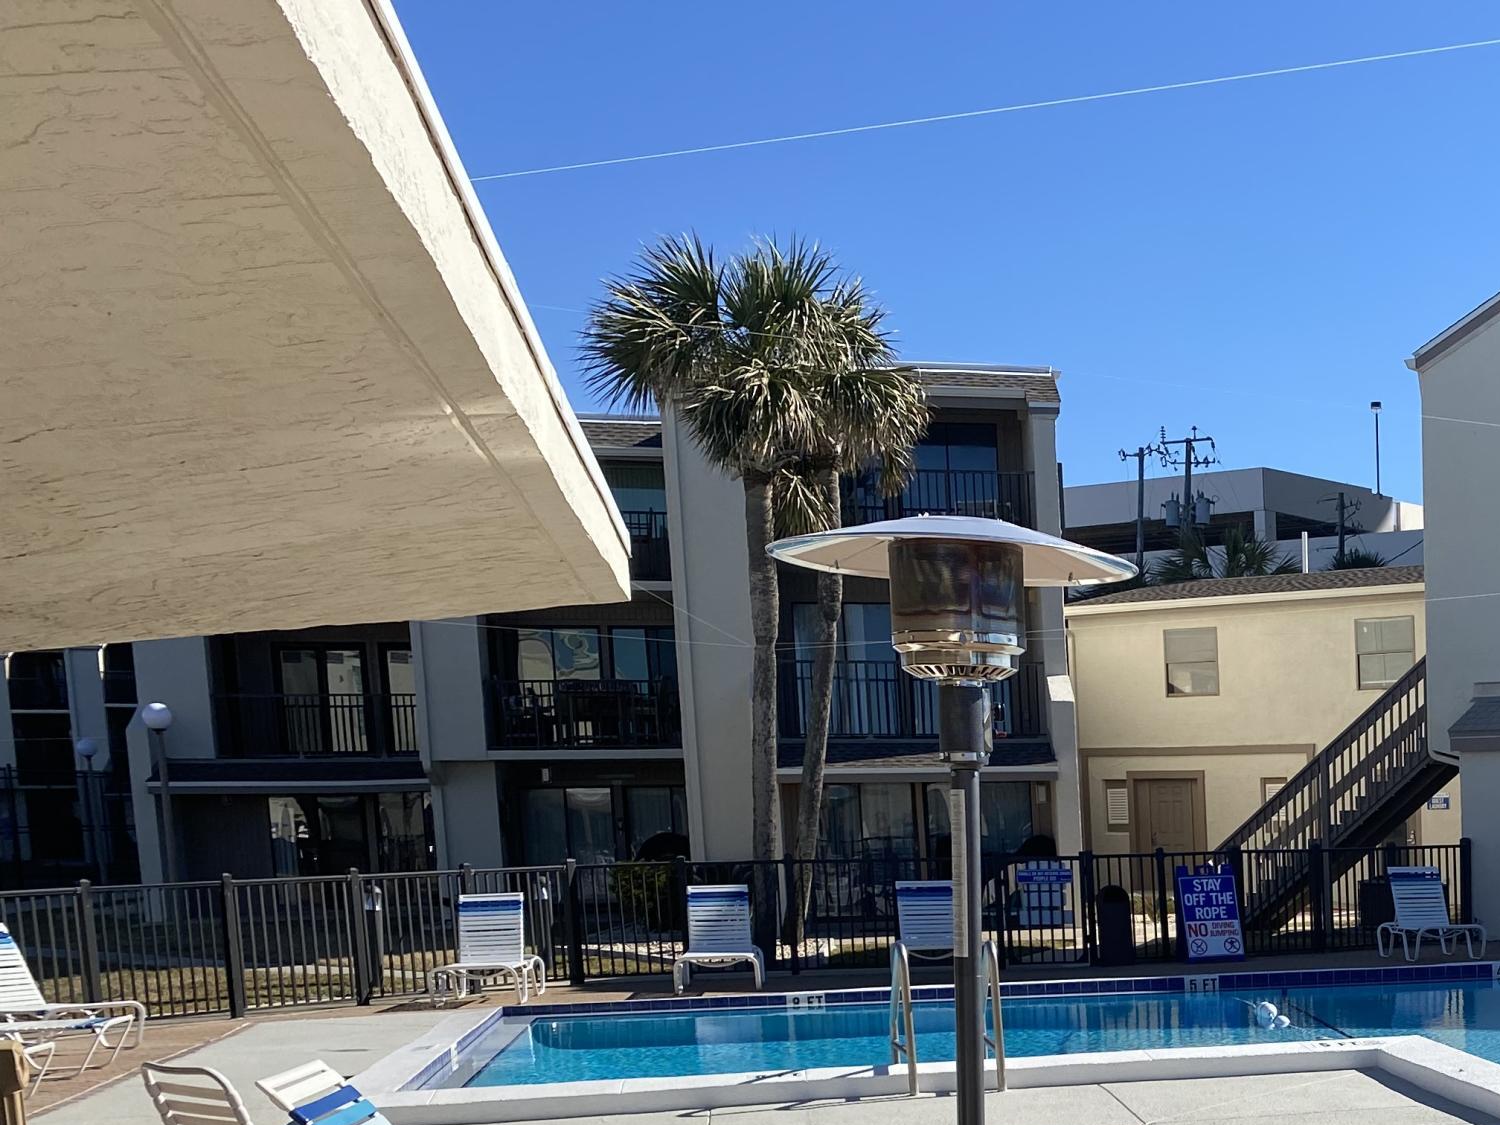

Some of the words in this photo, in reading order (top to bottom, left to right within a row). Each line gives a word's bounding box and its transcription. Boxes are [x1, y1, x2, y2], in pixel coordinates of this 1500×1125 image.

[1193, 878, 1221, 892] STAY
[1184, 893, 1206, 906] OFF
[1210, 892, 1234, 905] THE
[1195, 906, 1228, 920] ROPE
[1187, 923, 1208, 938] NO
[1210, 928, 1239, 937] JUMPING
[1203, 978, 1217, 991] FT
[808, 996, 823, 1005] FT
